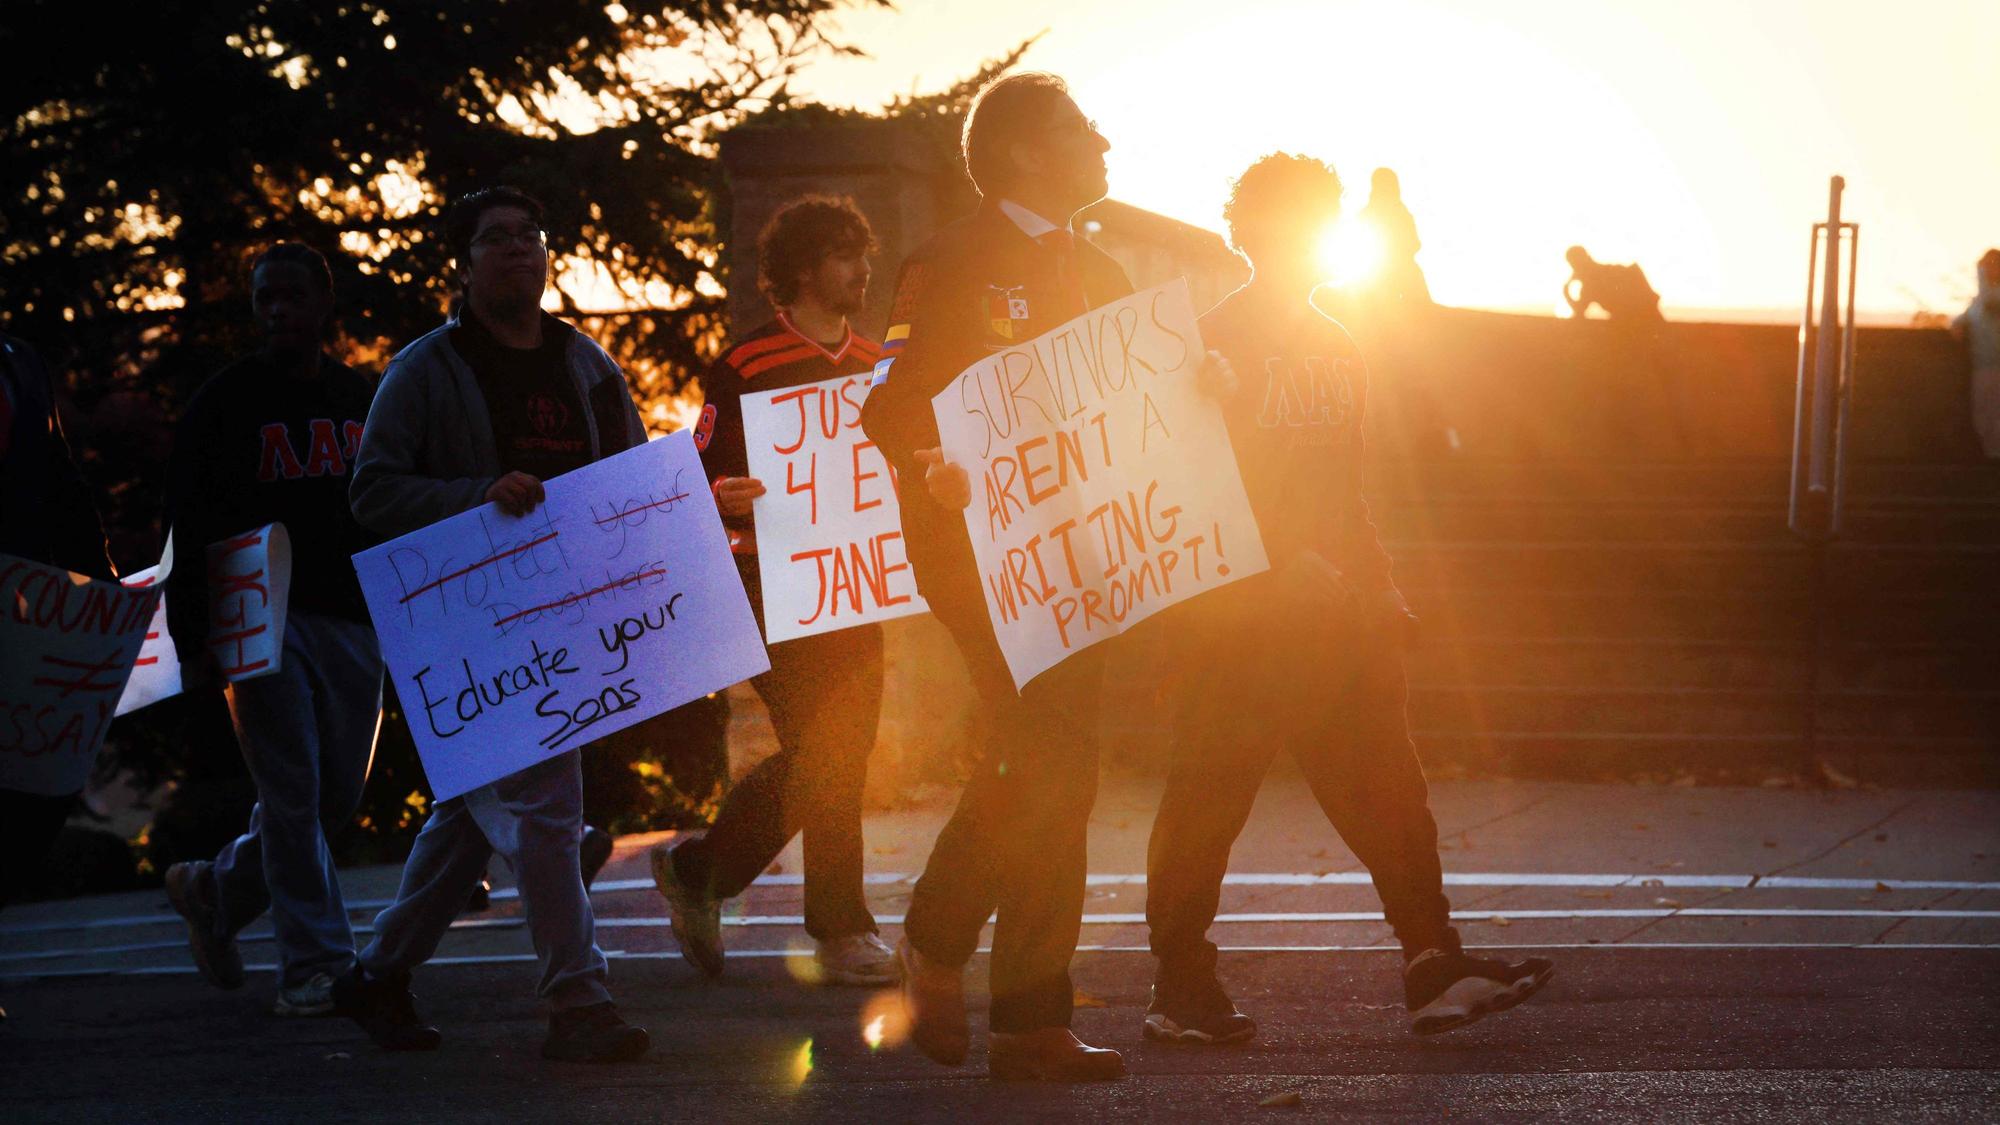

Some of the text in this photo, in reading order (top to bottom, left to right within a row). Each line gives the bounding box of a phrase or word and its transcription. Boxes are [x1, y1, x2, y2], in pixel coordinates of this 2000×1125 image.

[771, 379, 872, 455] JUS
[962, 291, 1188, 459] SURVIVORS
[787, 441, 899, 524] 4 E
[984, 392, 1170, 543] AREN'T A
[388, 468, 684, 628] Protect your
[484, 559, 666, 638] Daughters
[790, 531, 911, 625] JANE
[988, 480, 1183, 624] WRITING
[1052, 522, 1231, 648] PROMPT!
[413, 592, 684, 738] Educate your
[535, 678, 642, 746] Sons
